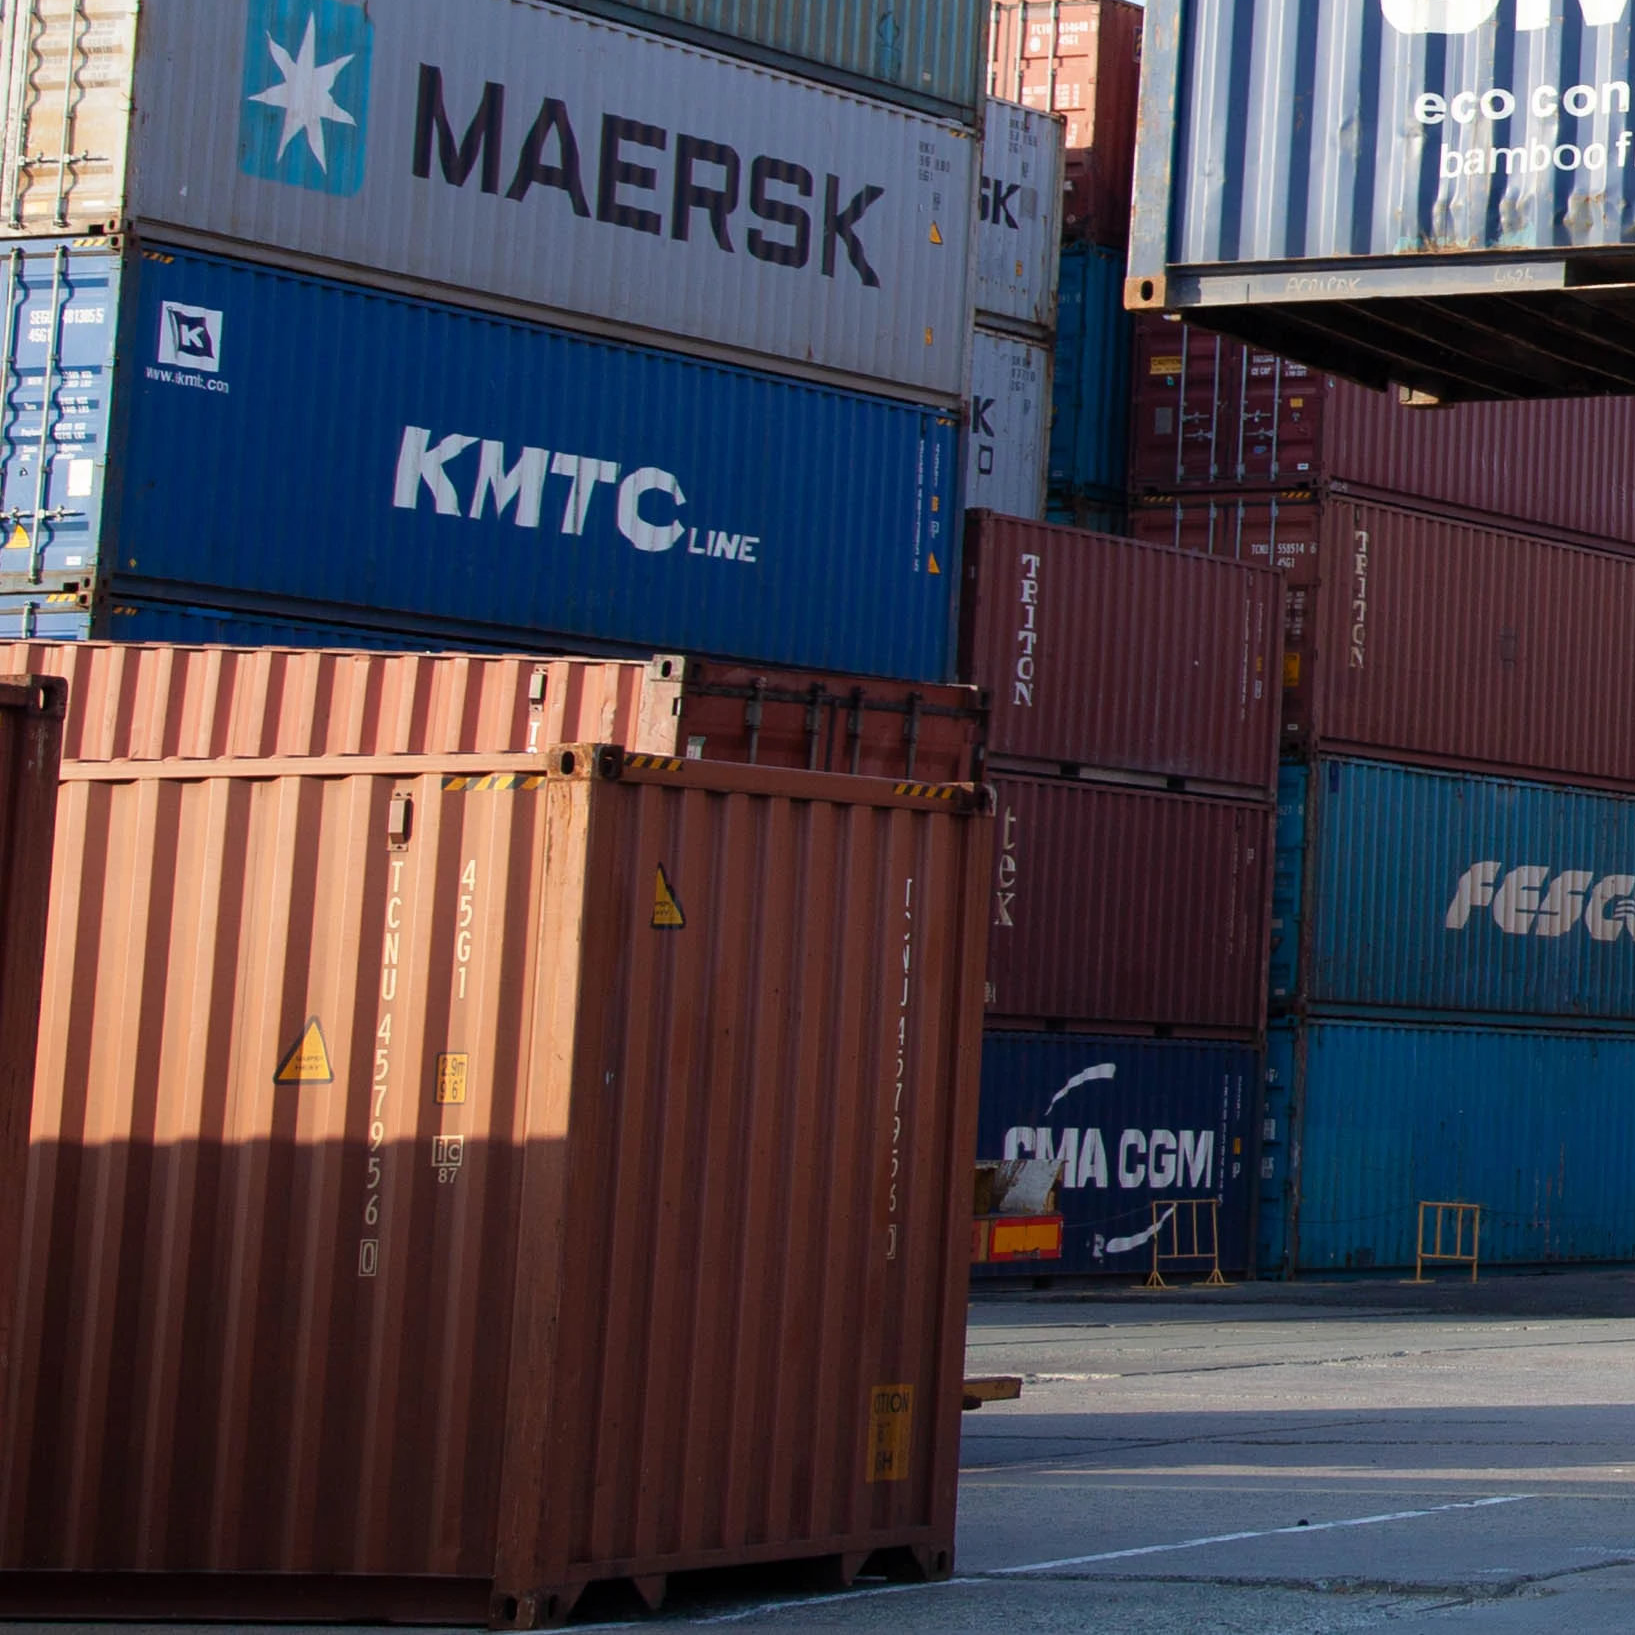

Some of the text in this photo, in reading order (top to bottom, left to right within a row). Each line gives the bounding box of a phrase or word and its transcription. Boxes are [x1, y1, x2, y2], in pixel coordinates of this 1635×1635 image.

[1413, 86, 1516, 126] eco
[411, 63, 886, 289] MAERSK
[1440, 130, 1606, 179] bamboo
[181, 323, 205, 348] K
[392, 425, 688, 553] KMTC
[687, 528, 761, 564] LINE
[1013, 554, 1040, 707] TRITON
[457, 859, 477, 1000] 45G1
[359, 861, 404, 1276] TCNU 457956 0
[438, 1168, 458, 1184] 87
[1118, 1128, 1215, 1189] CGM
